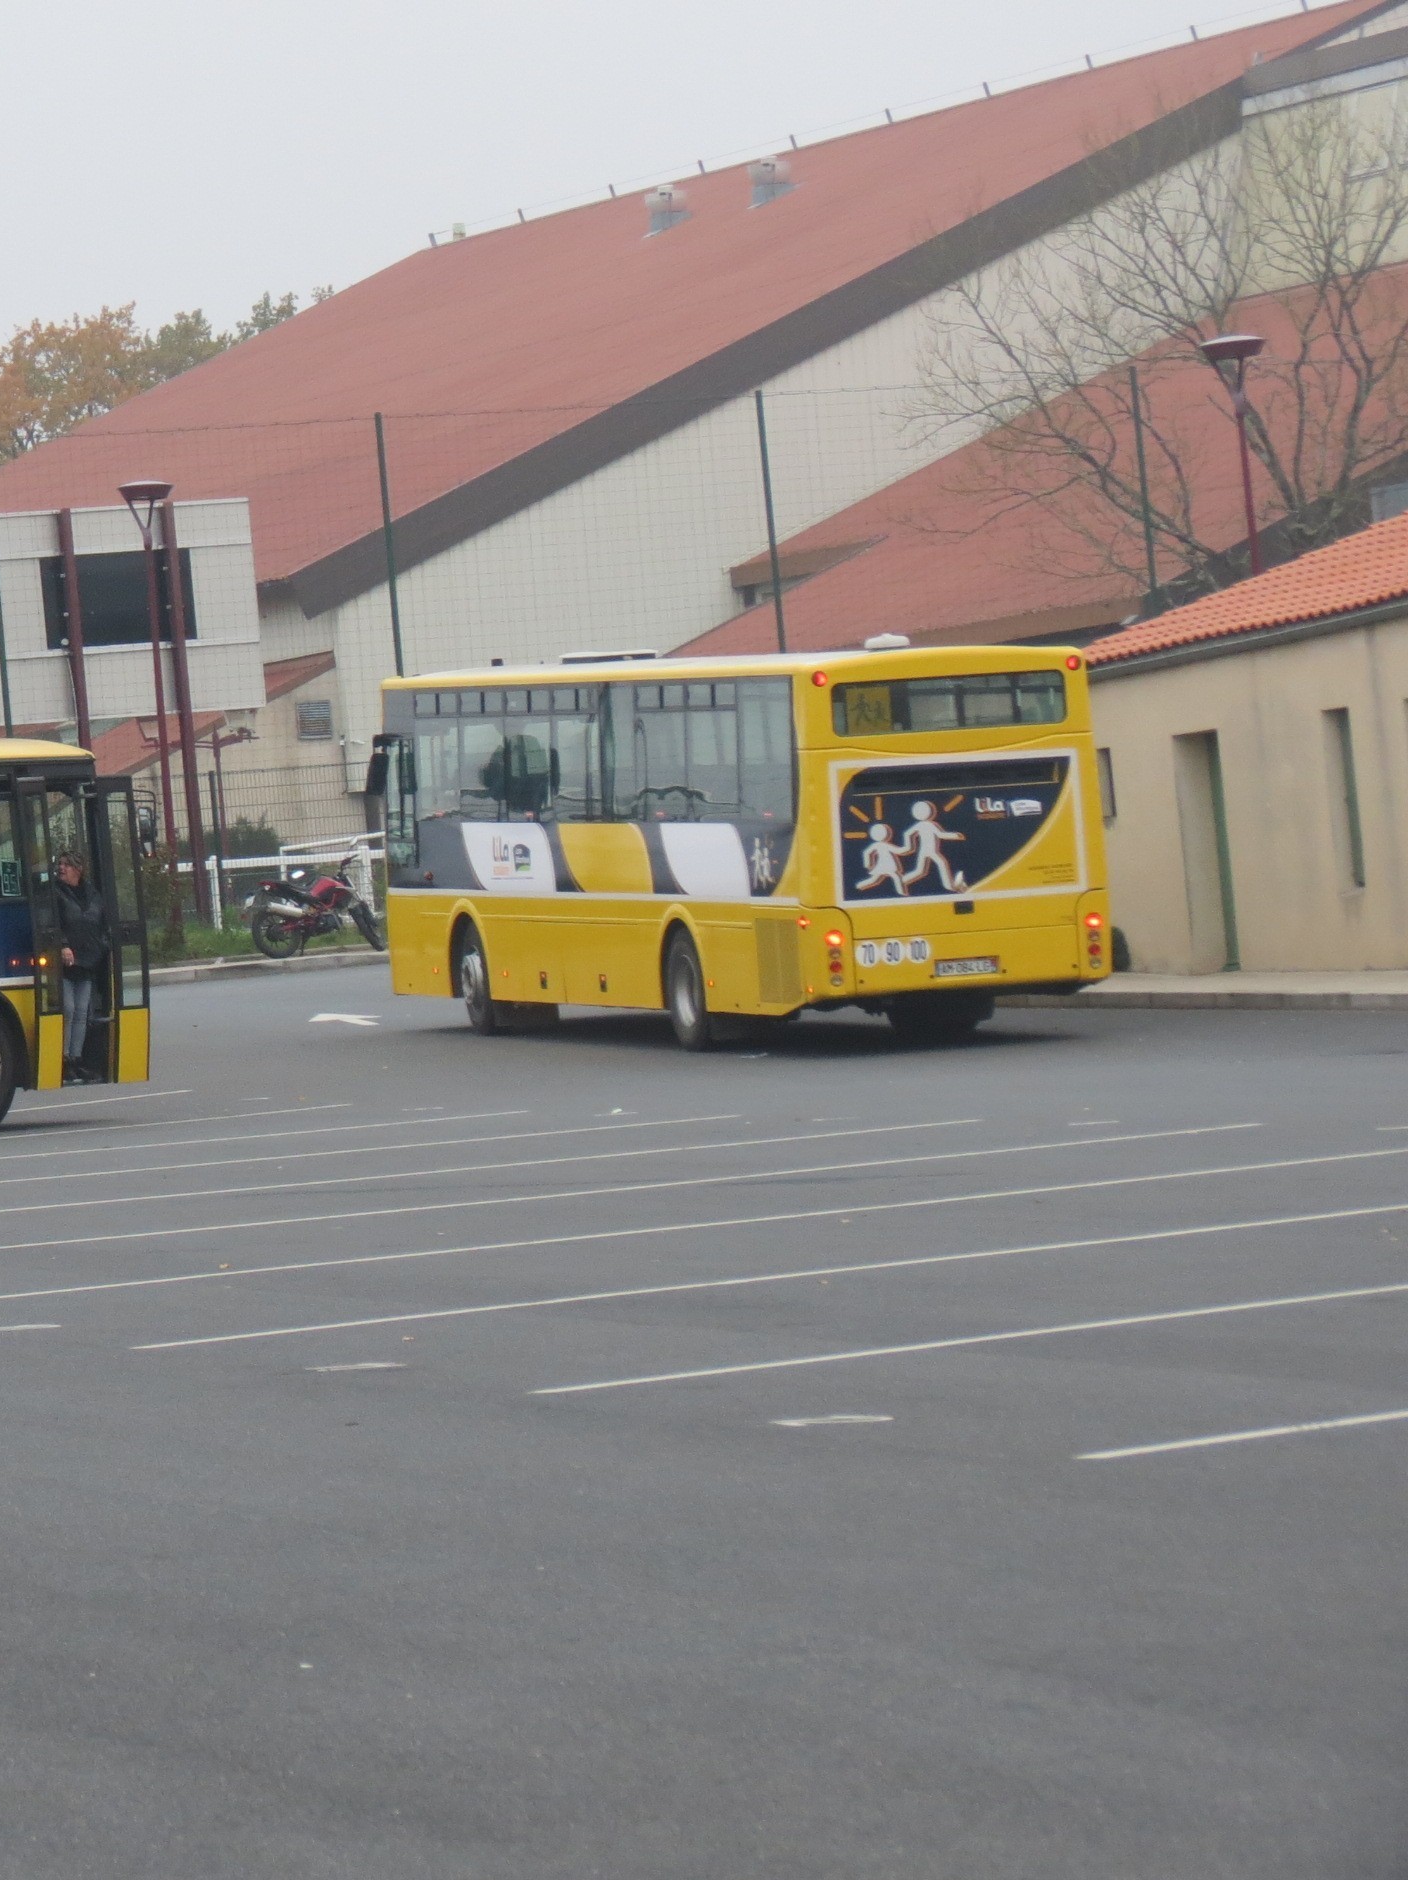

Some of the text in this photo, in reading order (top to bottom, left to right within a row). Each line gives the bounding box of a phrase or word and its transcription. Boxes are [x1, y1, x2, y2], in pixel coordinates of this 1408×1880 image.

[861, 940, 928, 964] 70 90 100
